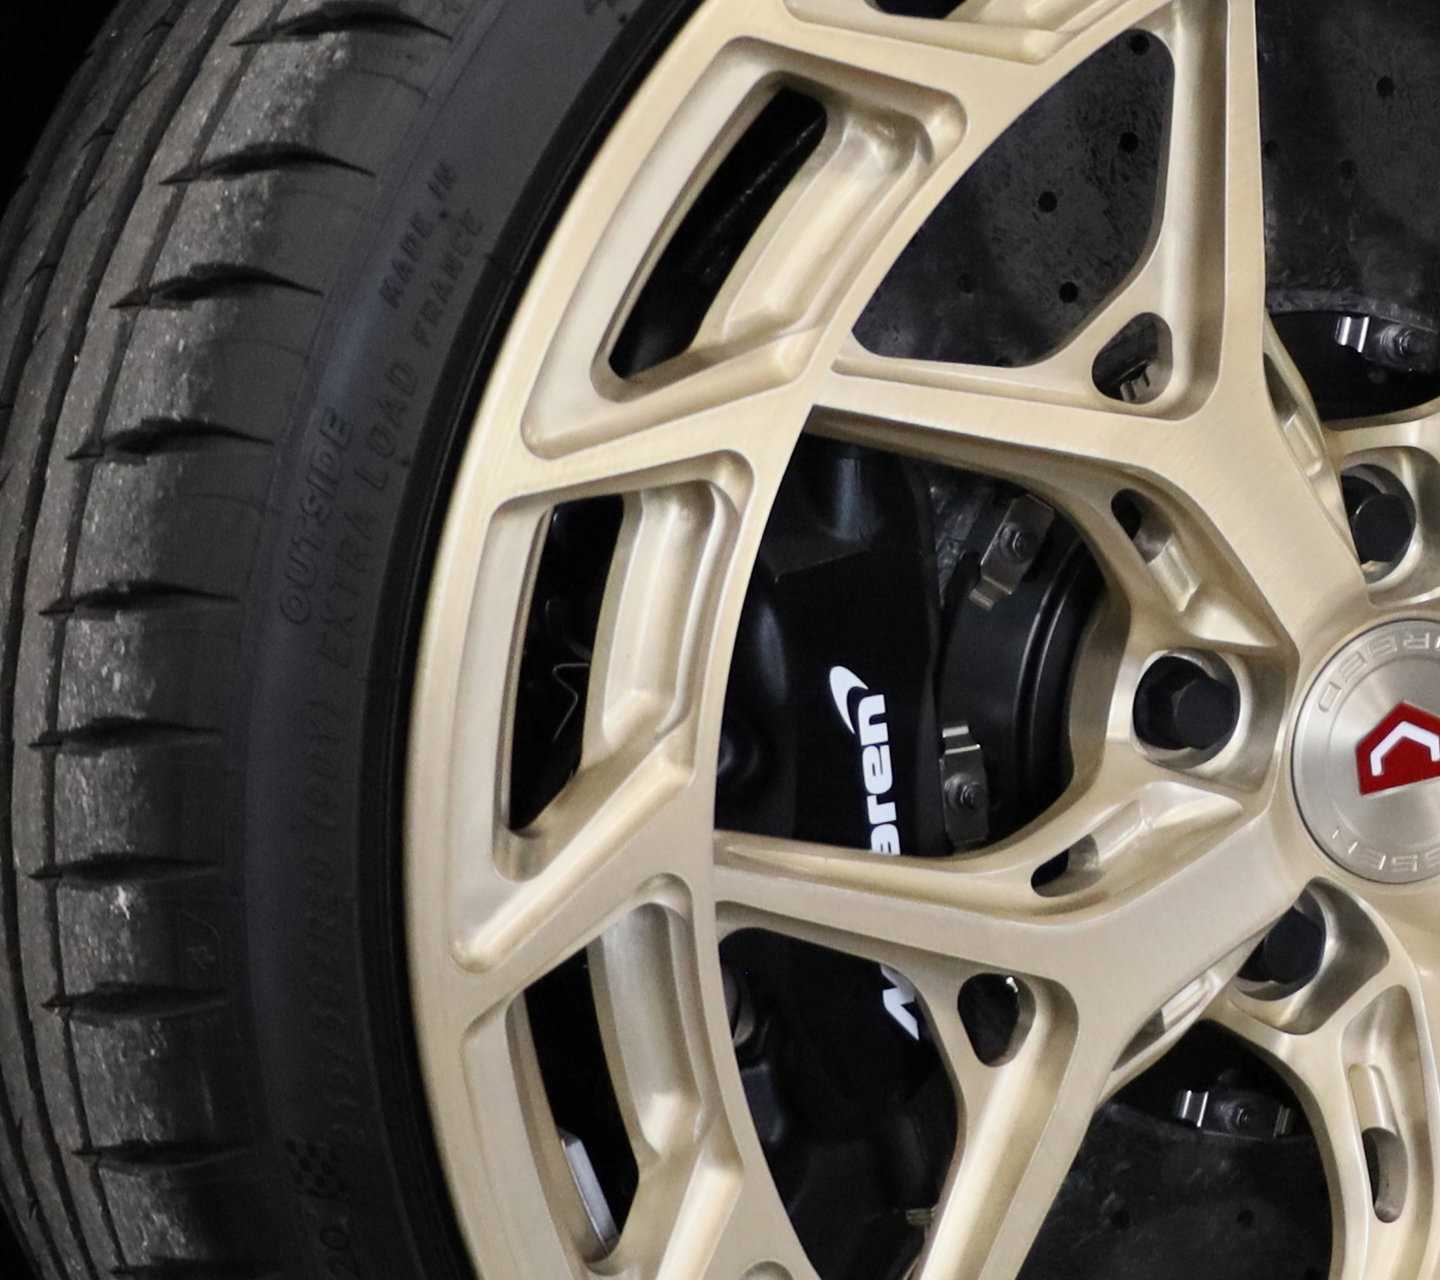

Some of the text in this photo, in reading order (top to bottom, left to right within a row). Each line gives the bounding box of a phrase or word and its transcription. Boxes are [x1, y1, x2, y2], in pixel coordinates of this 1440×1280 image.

[377, 209, 436, 310] MADE
[411, 207, 482, 347] FRANCE
[280, 409, 354, 626] OUTSIDE
[317, 506, 375, 669] EXTRA
[356, 360, 419, 493] LOAD
